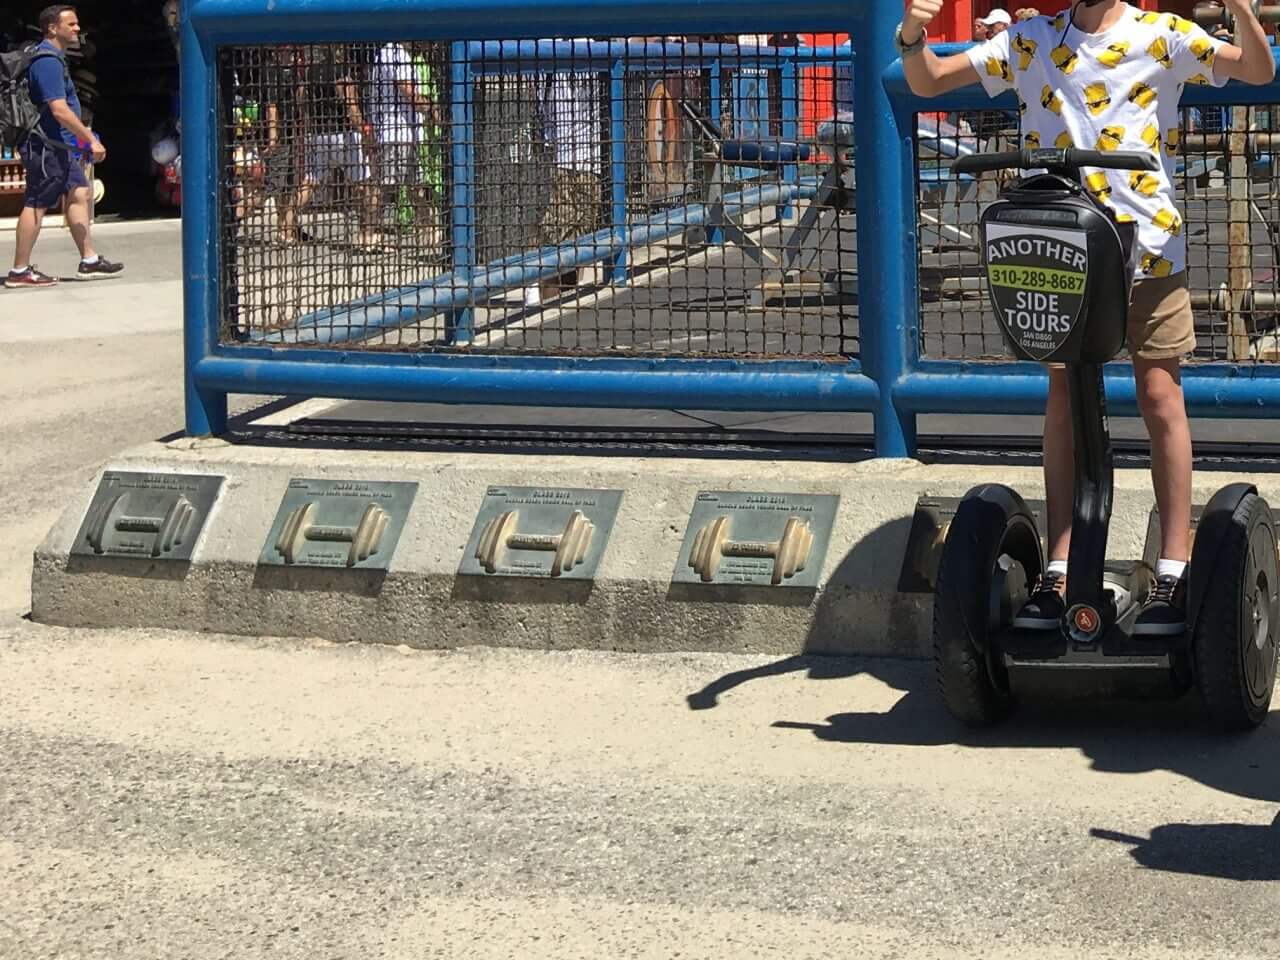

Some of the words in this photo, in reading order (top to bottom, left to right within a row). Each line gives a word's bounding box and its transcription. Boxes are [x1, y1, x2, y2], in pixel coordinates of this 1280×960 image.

[987, 239, 1086, 271] ANOTHER
[992, 269, 1084, 291] 310-289-8687
[1016, 291, 1059, 312] SIDE
[1004, 309, 1071, 332] TOURS
[1020, 339, 1031, 347] LOS
[1031, 340, 1056, 348] ANGELES
[1035, 332, 1052, 340] DIEGO
